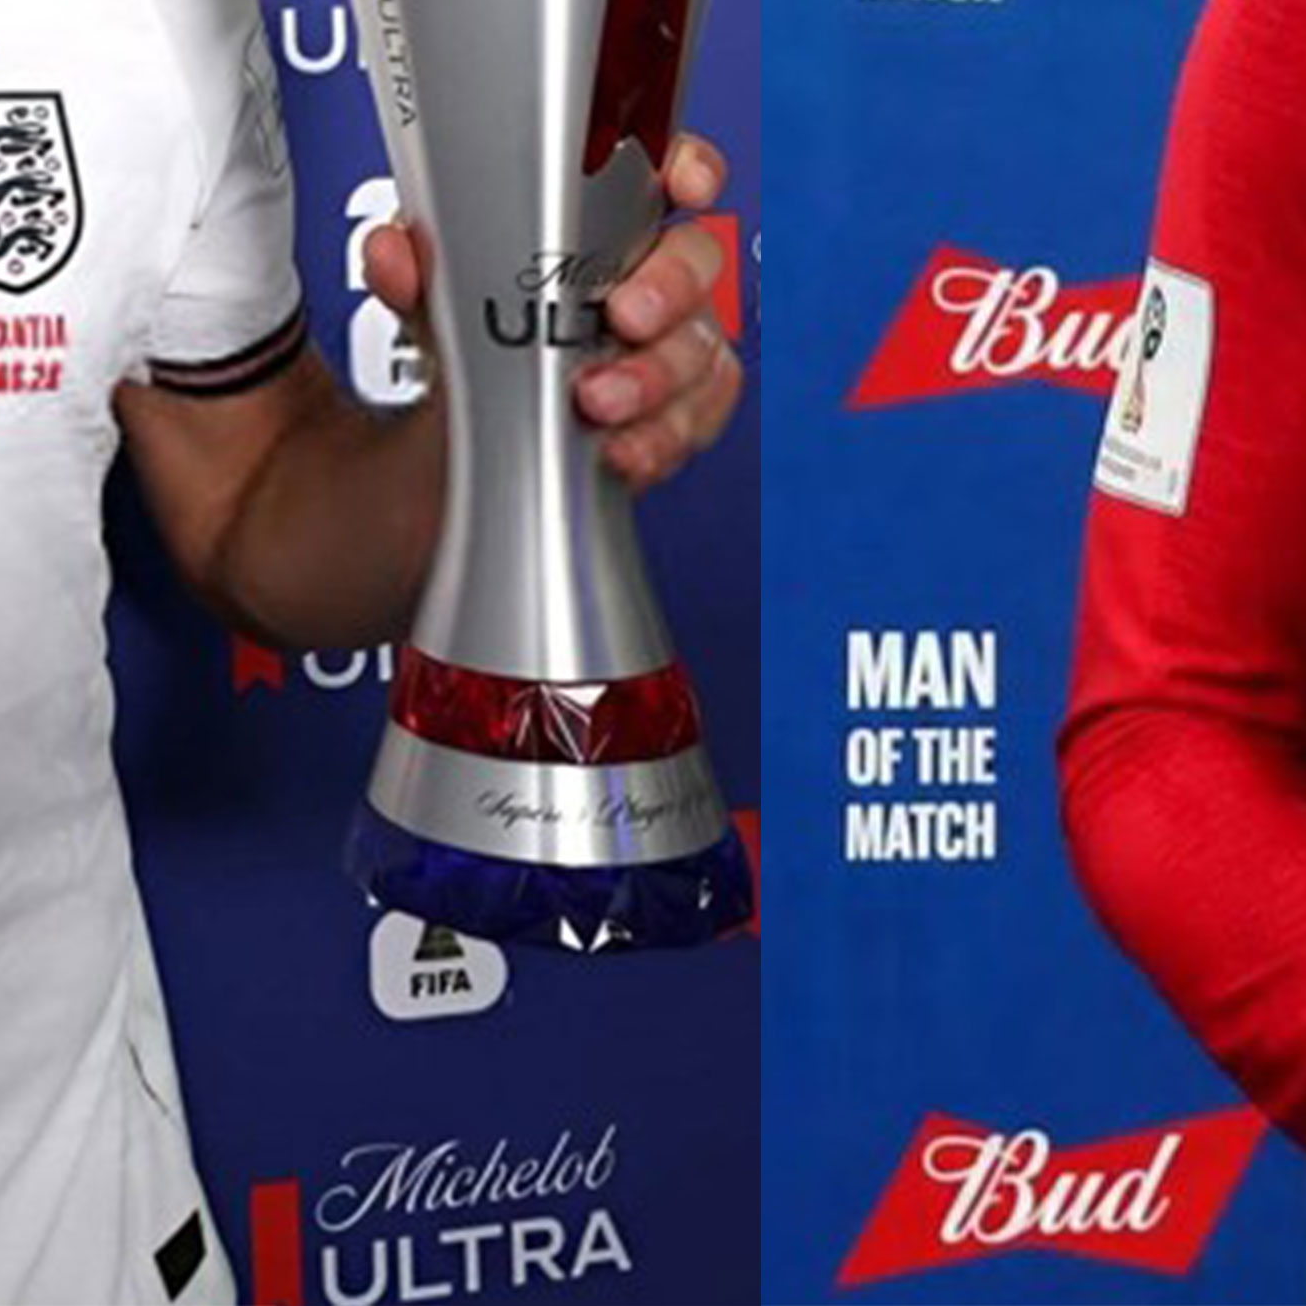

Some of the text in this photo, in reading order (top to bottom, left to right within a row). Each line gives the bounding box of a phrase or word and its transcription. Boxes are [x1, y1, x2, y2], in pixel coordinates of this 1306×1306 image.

[484, 297, 607, 348] ULT
[846, 630, 997, 711] MAN
[846, 727, 997, 787] OF THE
[845, 801, 997, 861] MATCH
[410, 968, 473, 999] FIFA
[315, 1124, 619, 1232] Michelob
[923, 1129, 1183, 1245] Bud
[320, 1209, 633, 1306] ULTRA
